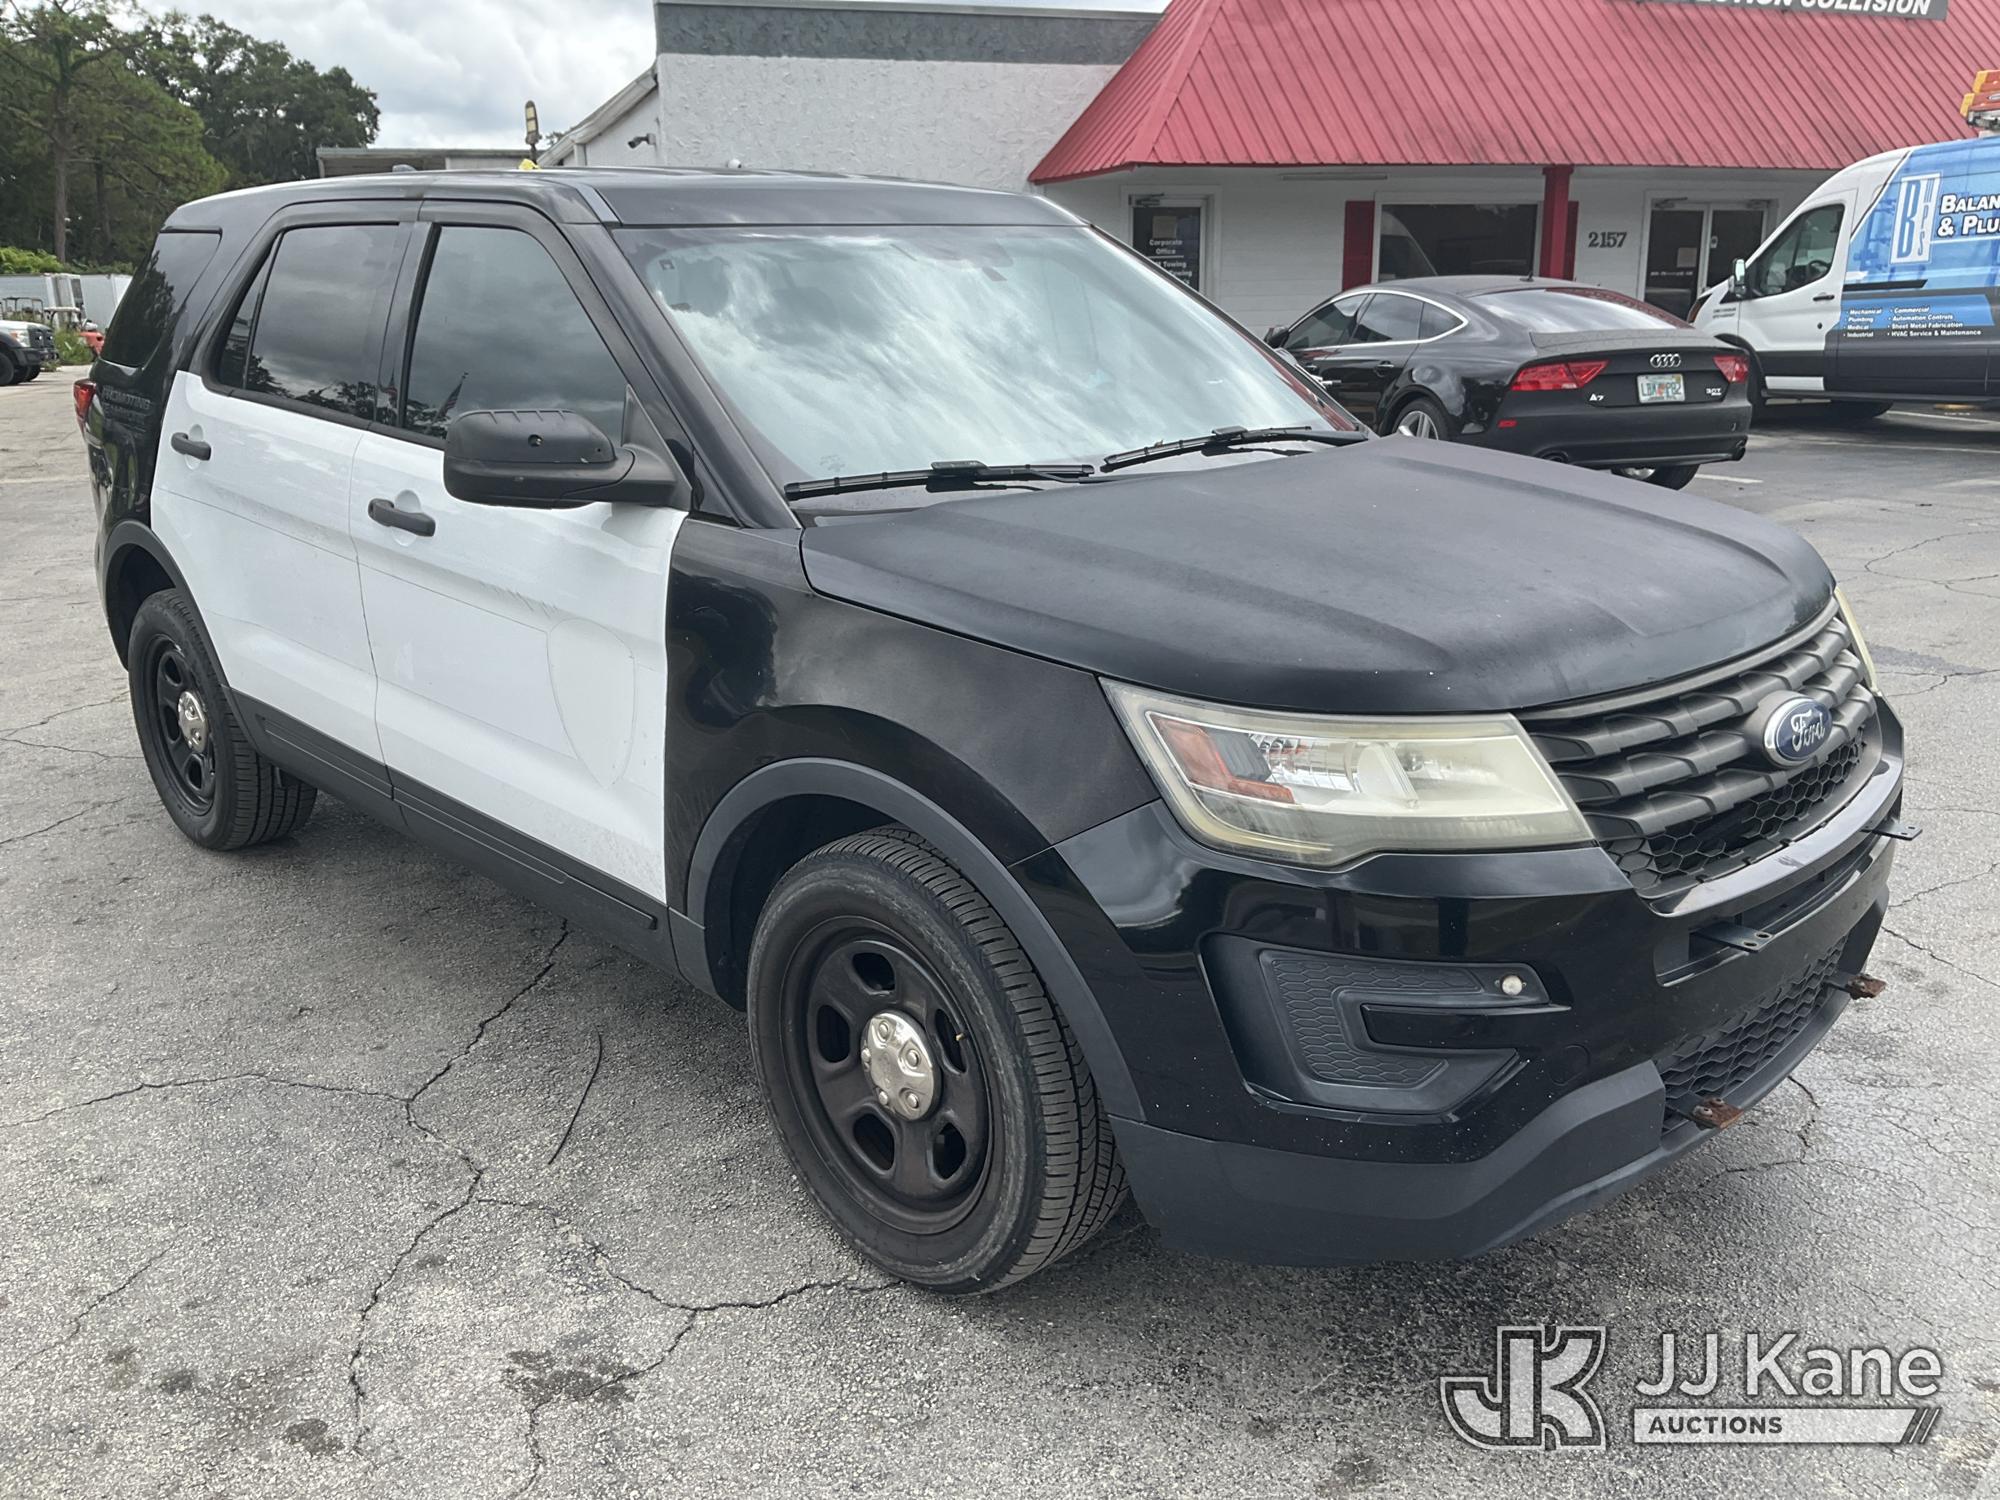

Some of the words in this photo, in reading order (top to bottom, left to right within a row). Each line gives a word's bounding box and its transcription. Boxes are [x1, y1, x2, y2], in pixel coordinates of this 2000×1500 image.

[1937, 216, 1955, 237] &
[1149, 239, 1183, 247] Corporate
[1588, 231, 1627, 248] 2157
[1163, 260, 1187, 269] Towing
[1589, 393, 1604, 401] A7
[1791, 709, 1826, 752] Ford
